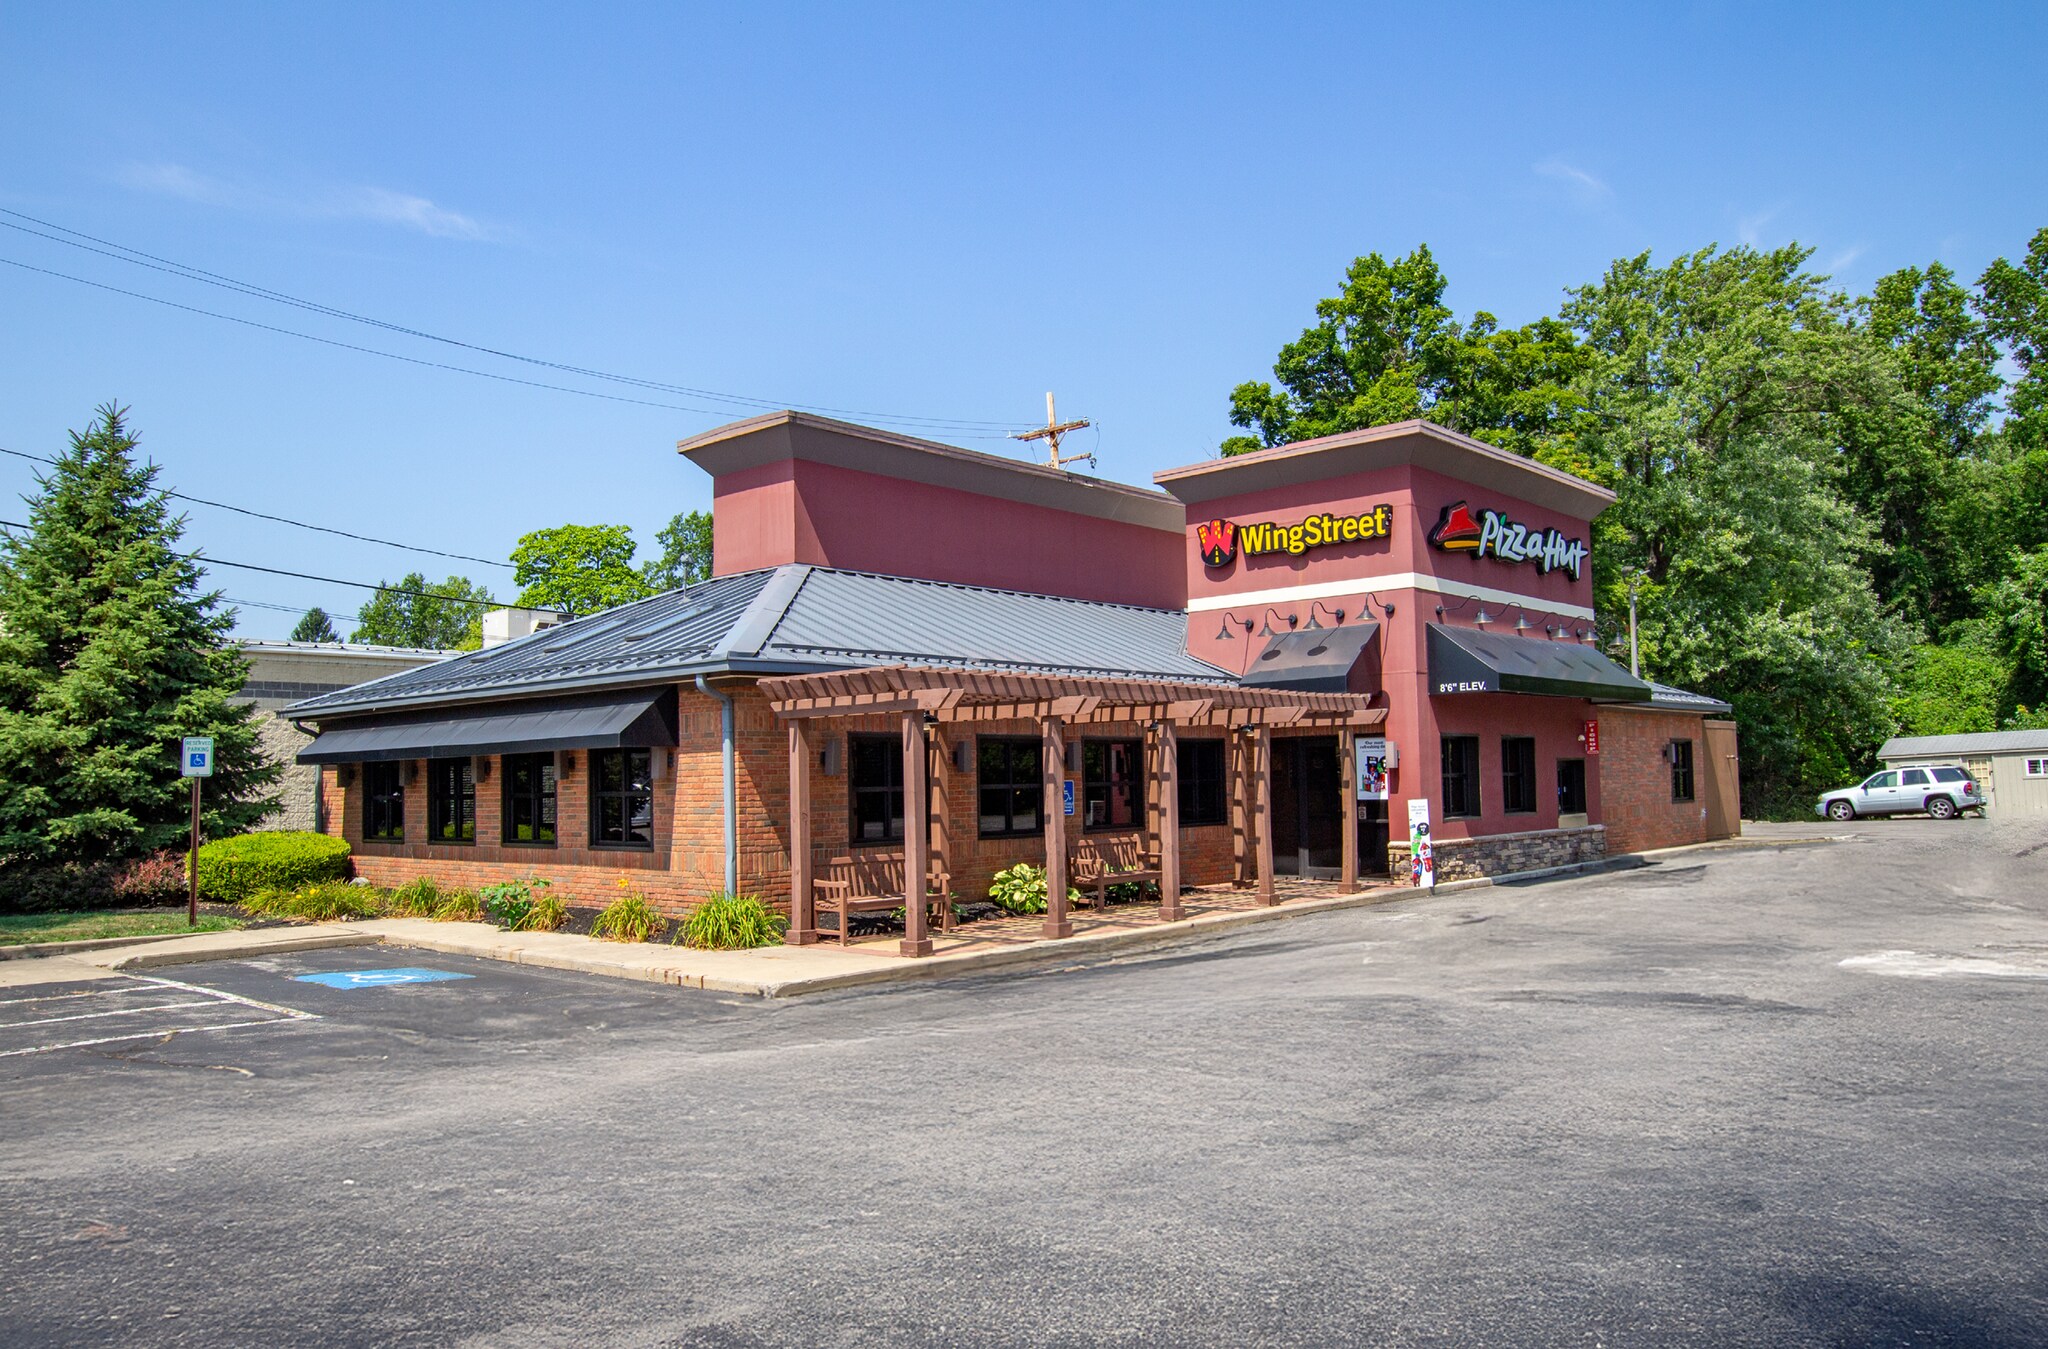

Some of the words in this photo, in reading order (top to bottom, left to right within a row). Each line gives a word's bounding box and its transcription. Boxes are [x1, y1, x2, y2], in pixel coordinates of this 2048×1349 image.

[1241, 507, 1387, 554] WingStreet
[1479, 511, 1544, 562] Pizza
[1543, 529, 1589, 581] Hut
[1440, 682, 1457, 692] 8'6"
[1459, 681, 1487, 691] ELEV.
